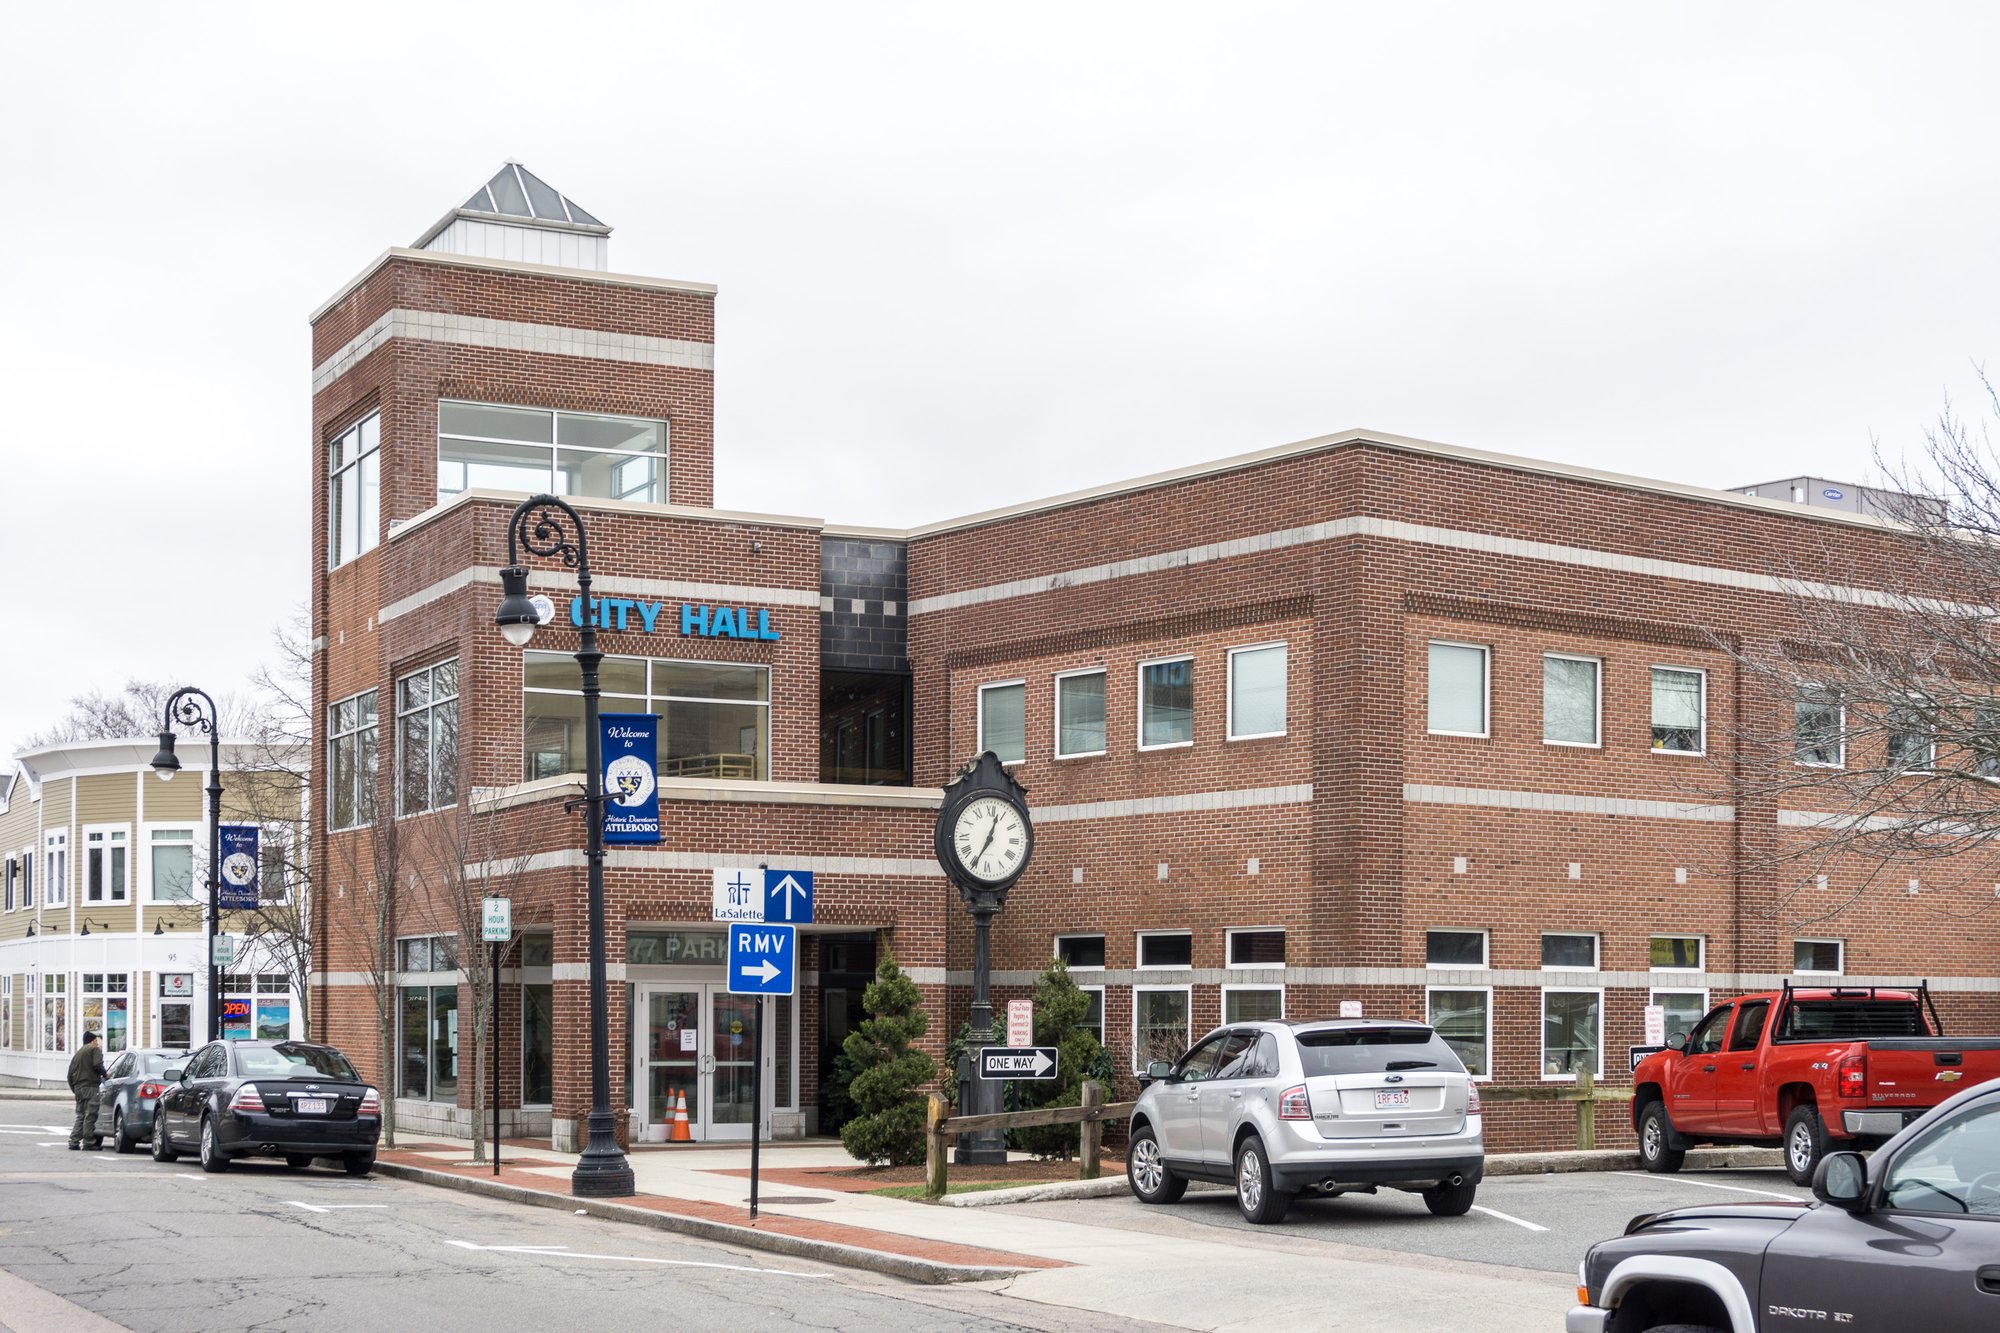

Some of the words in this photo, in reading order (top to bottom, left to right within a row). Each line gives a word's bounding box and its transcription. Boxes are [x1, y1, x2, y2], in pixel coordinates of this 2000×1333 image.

[570, 595, 662, 633] CITY
[681, 603, 780, 640] HALL
[608, 726, 650, 738] Welcome
[624, 739, 634, 748] to
[605, 814, 627, 823] Historic
[628, 814, 658, 823] Downtown
[604, 823, 658, 832] ATTLEBORO
[225, 834, 254, 842] Welcome
[494, 904, 499, 912] 2
[488, 915, 505, 924] HOUR
[485, 927, 508, 935] PARKING
[630, 938, 658, 958] 77
[738, 933, 785, 954] RMV
[223, 1003, 250, 1015] OPEN
[989, 1057, 1010, 1069] ONE
[1013, 1057, 1035, 1069] WAY
[1377, 1094, 1391, 1104] 1RF
[1394, 1093, 1409, 1104] 516
[1768, 1305, 1827, 1320] DAKOTA
